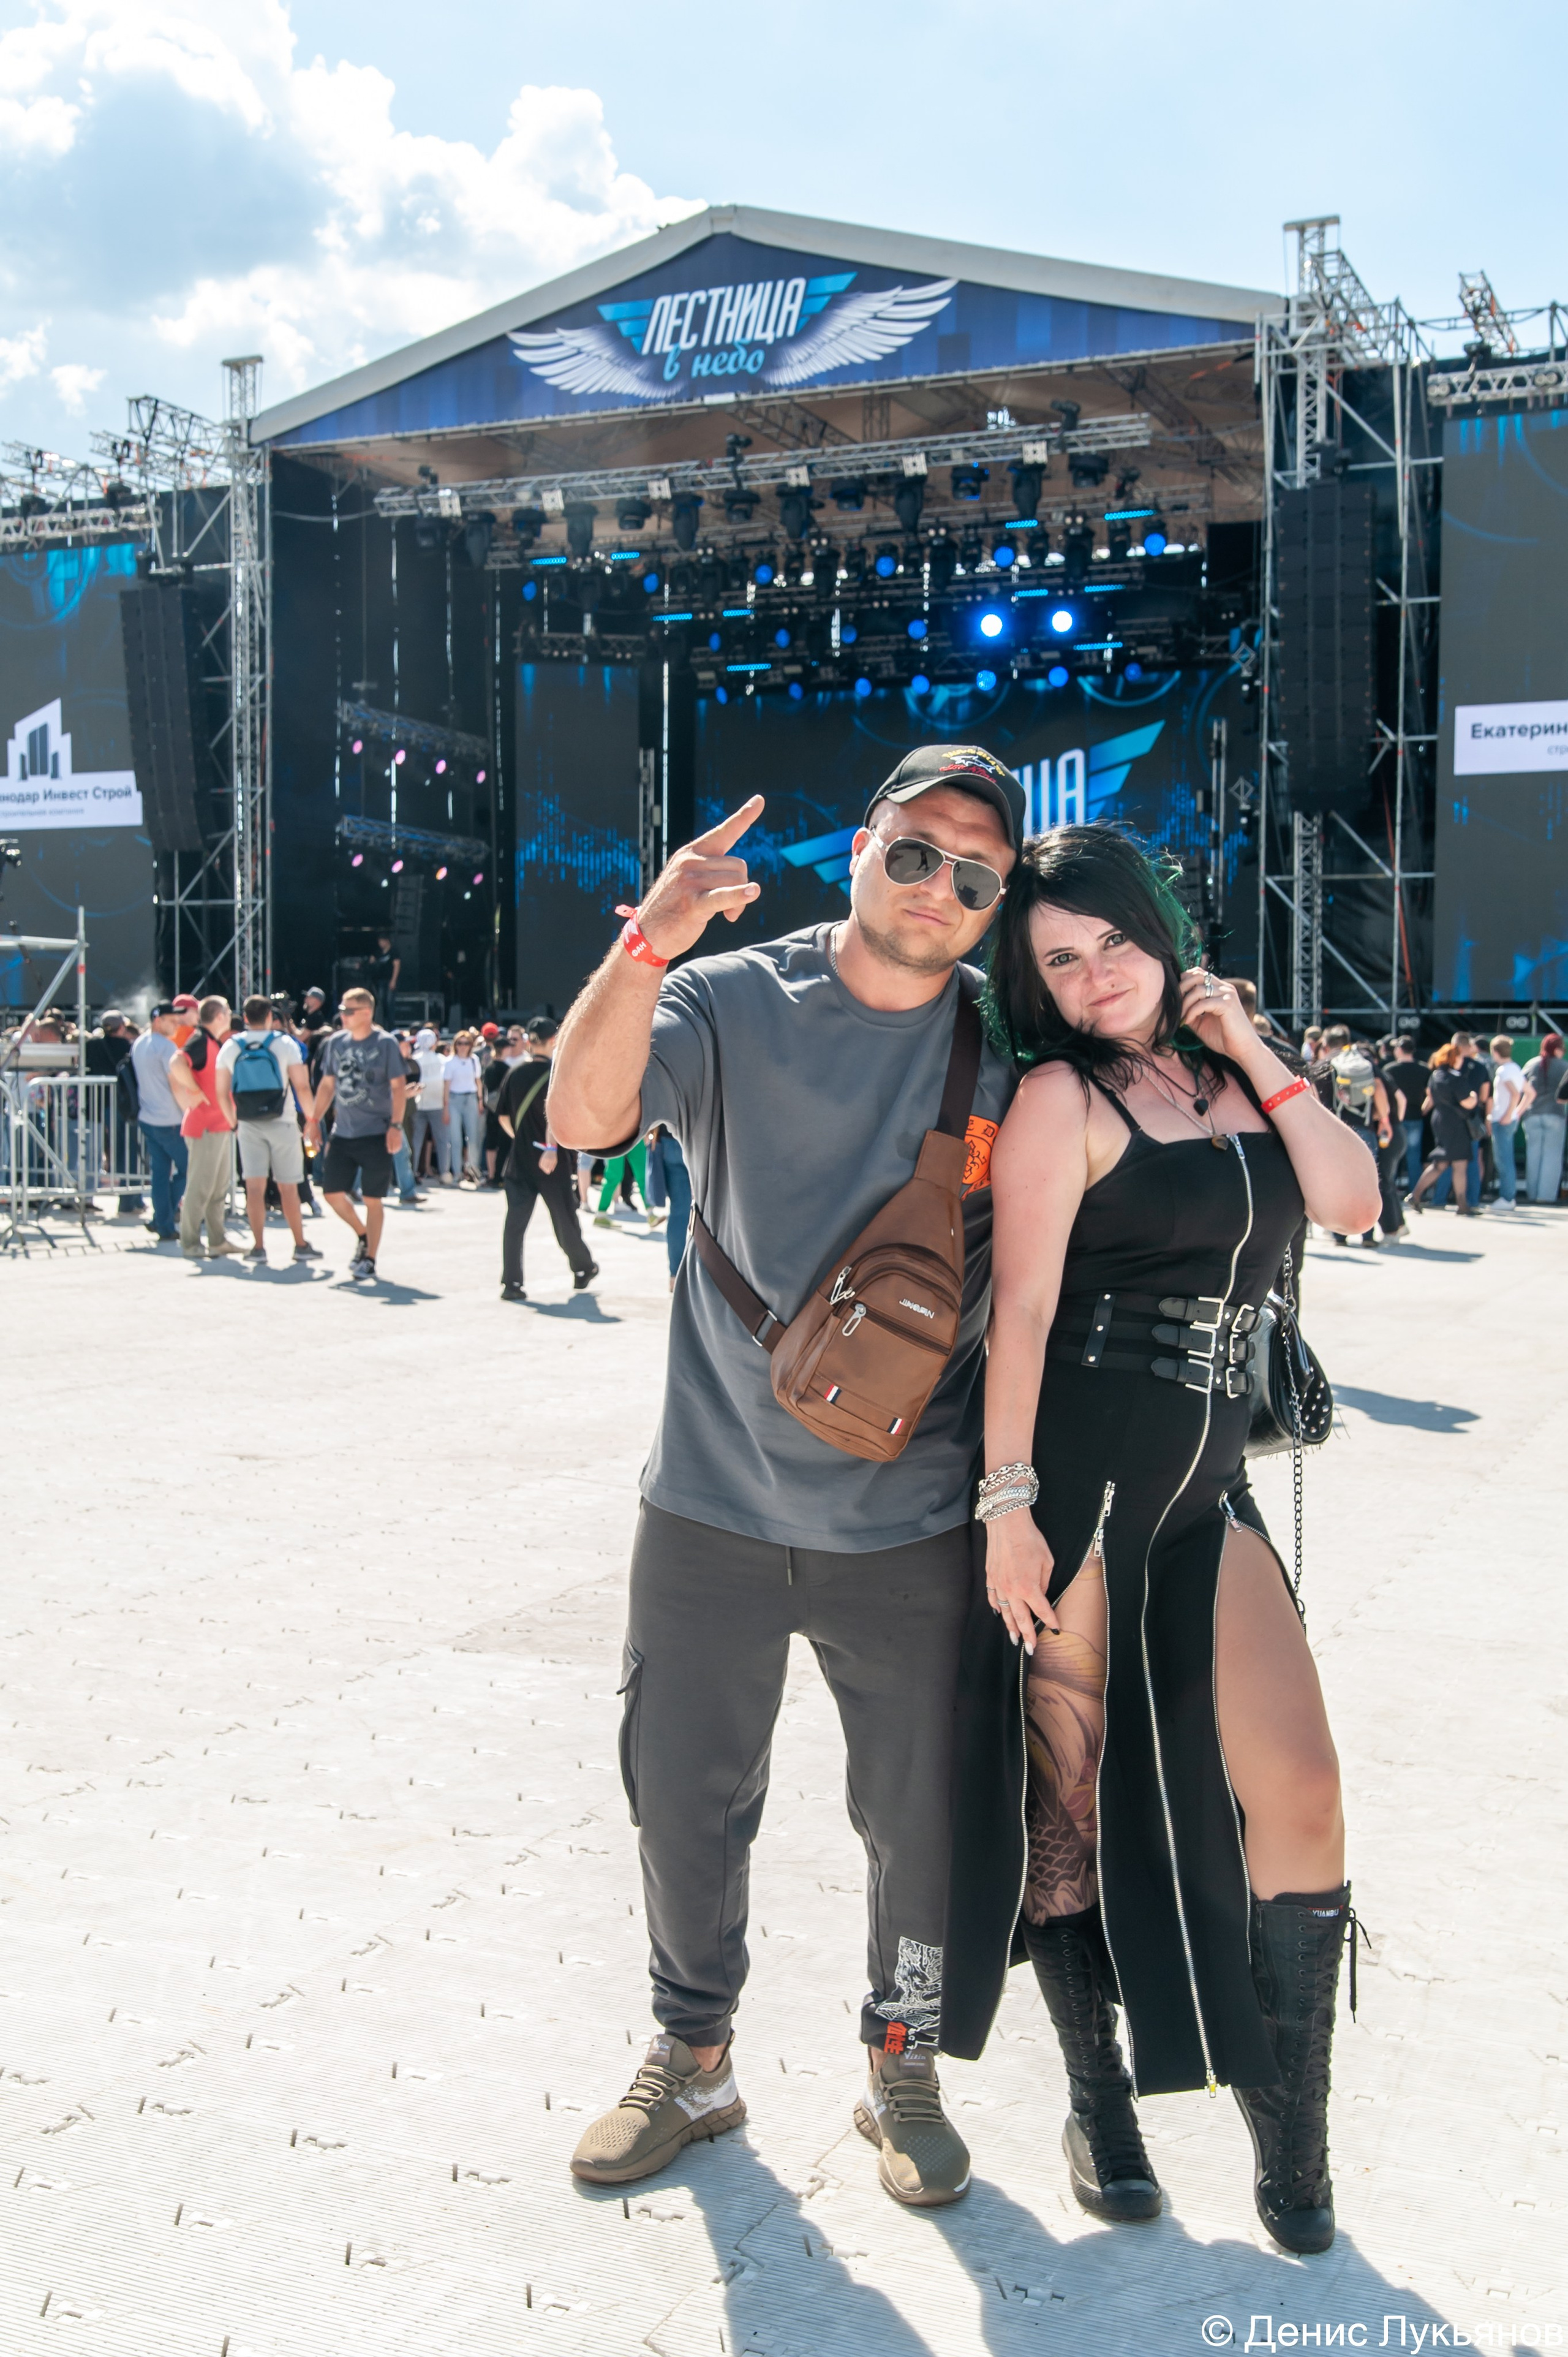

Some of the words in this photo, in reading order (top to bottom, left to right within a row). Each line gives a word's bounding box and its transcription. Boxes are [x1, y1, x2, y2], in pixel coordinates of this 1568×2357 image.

[641, 276, 806, 355] ЛЕСТНИЦА
[663, 341, 682, 382] в
[691, 338, 765, 379] небо
[43, 787, 88, 802] Инвест
[92, 784, 132, 801] Строй
[631, 941, 647, 957] ФАН
